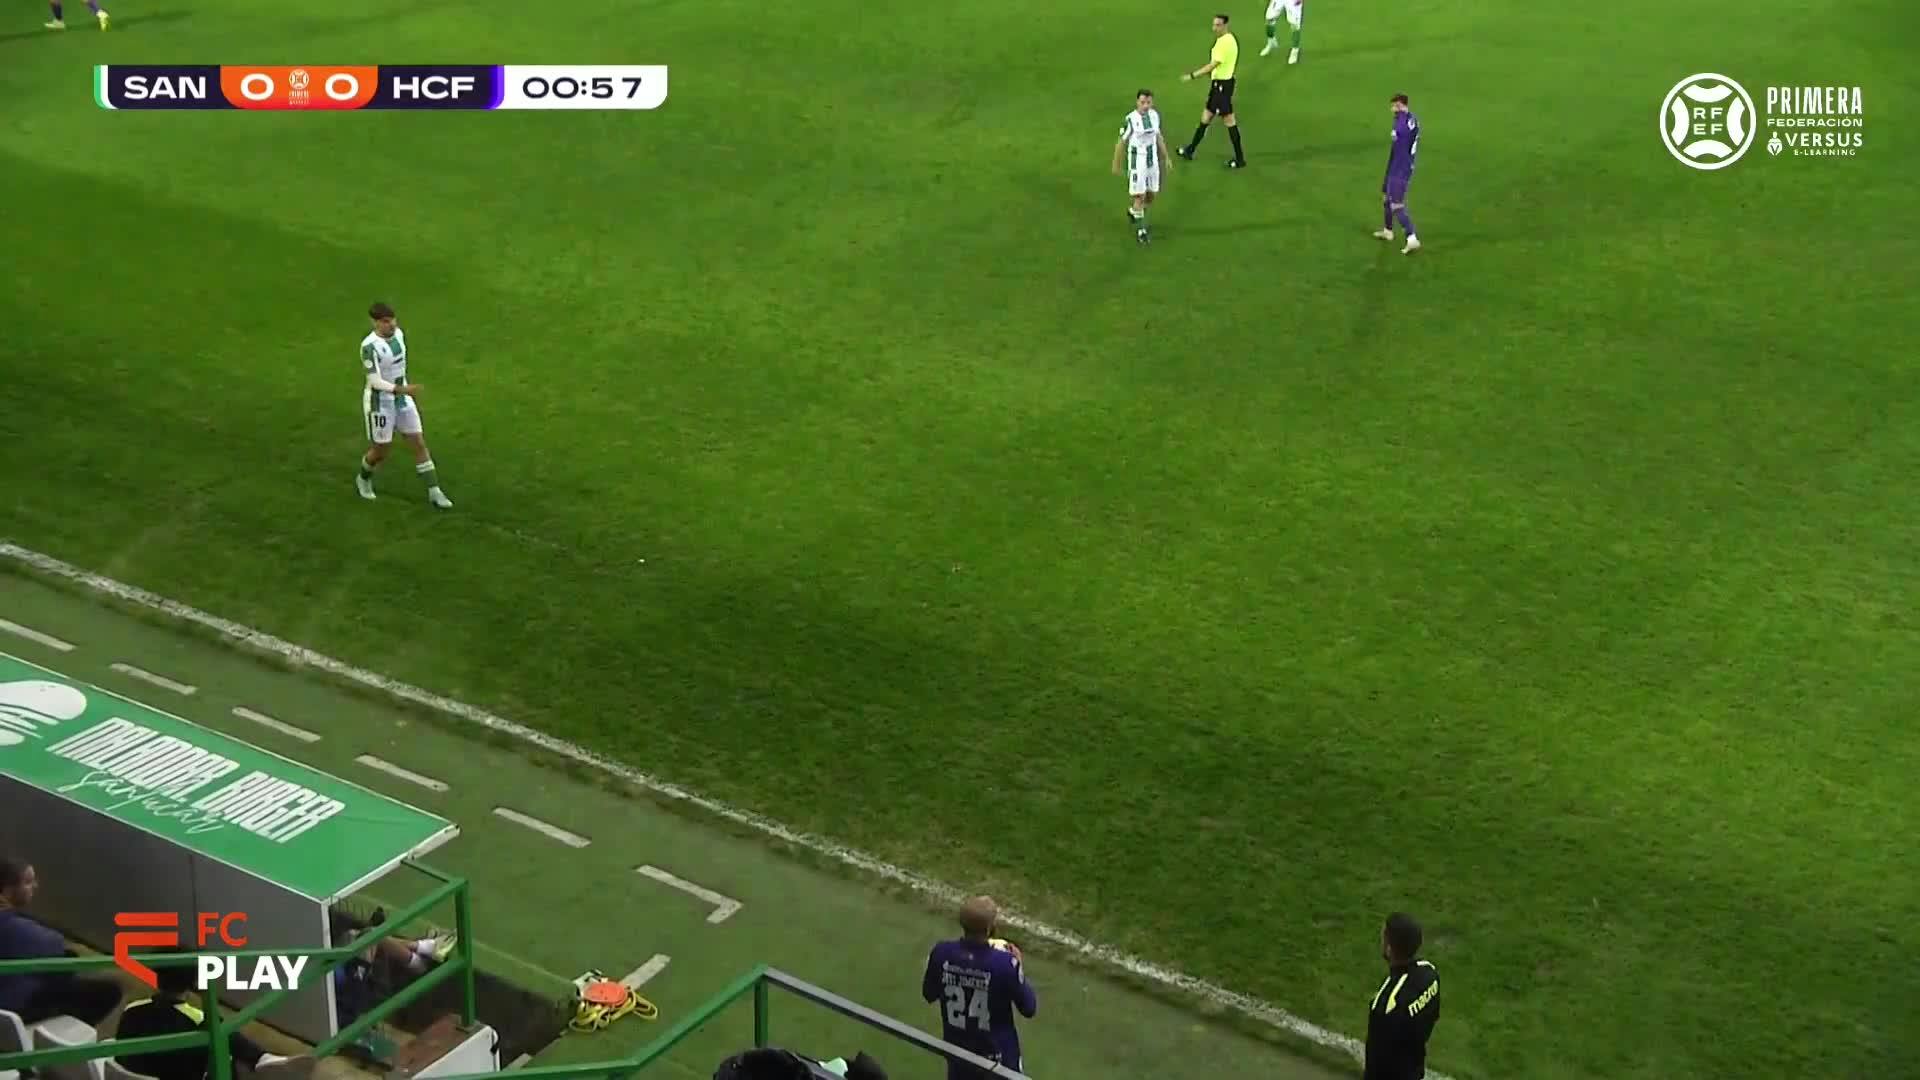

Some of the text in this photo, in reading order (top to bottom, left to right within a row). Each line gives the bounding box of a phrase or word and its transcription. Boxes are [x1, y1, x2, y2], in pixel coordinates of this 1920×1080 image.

[374, 415, 387, 428] 10
[190, 770, 347, 844] BURGER
[943, 985, 991, 1032] 24
